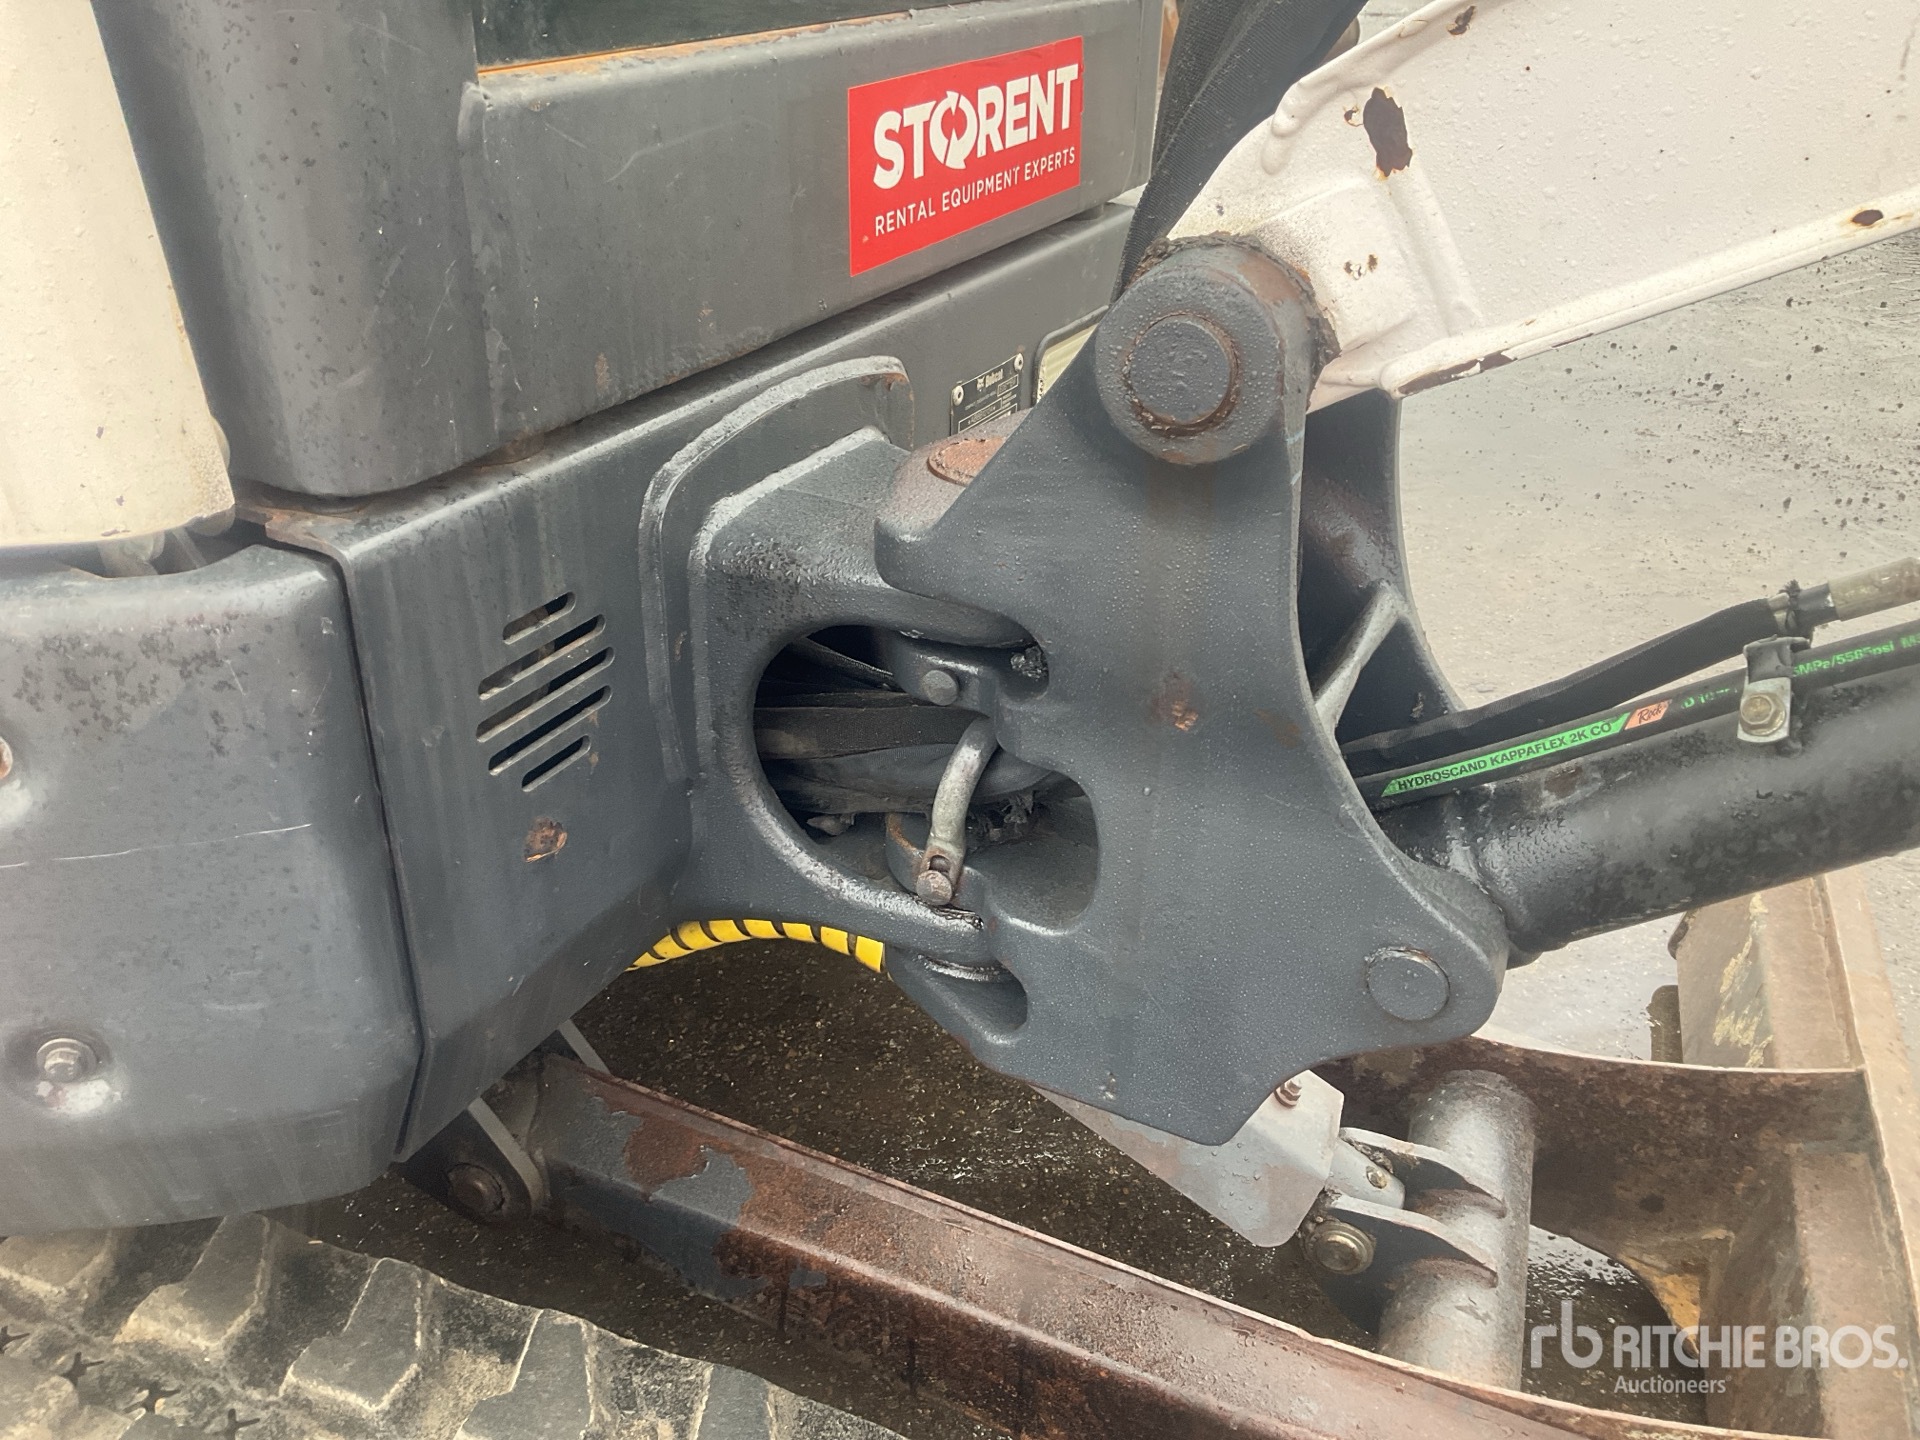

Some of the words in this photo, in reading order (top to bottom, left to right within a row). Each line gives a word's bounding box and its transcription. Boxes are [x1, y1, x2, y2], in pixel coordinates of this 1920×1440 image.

[873, 63, 1079, 189] STORENT
[874, 197, 936, 236] RENTAL
[942, 166, 1020, 212] EQUIPMENT
[1024, 146, 1076, 181] EXPERTS
[1398, 759, 1488, 791] HYDROSCAND
[1490, 735, 1567, 767] KAPPAFLEX
[1570, 730, 1588, 743] 2K
